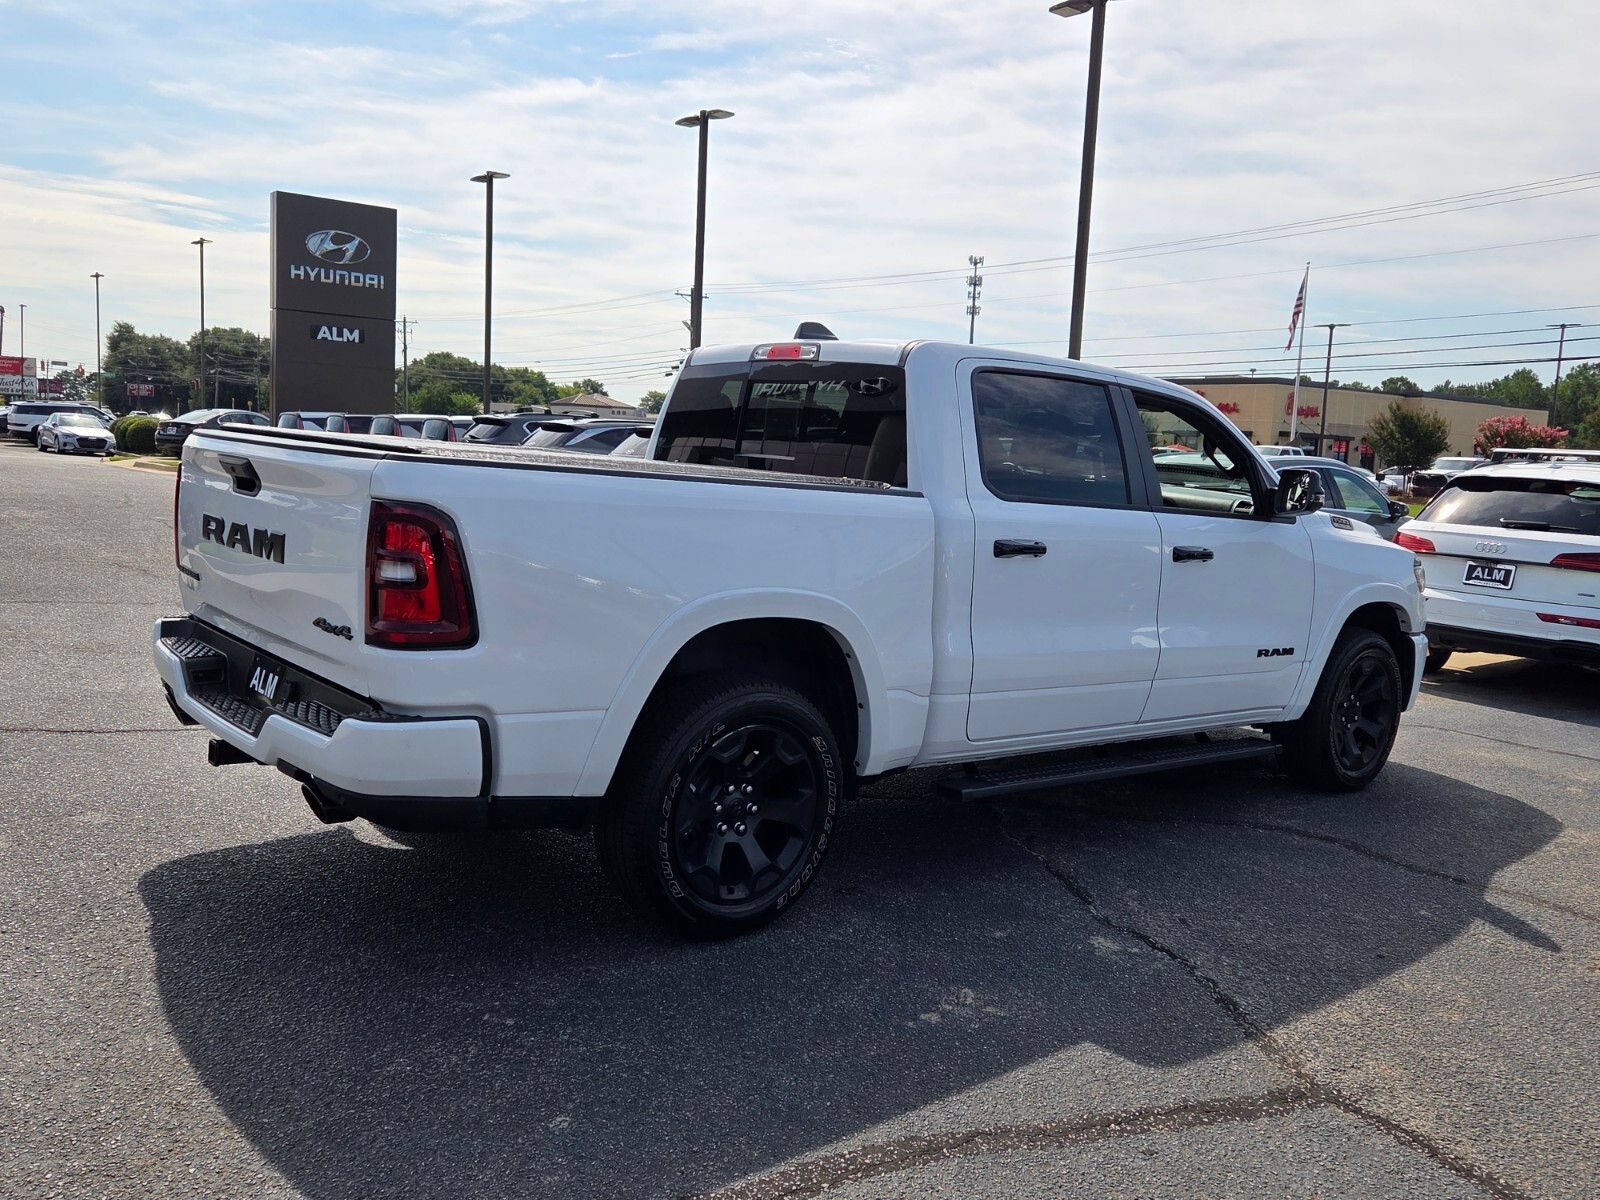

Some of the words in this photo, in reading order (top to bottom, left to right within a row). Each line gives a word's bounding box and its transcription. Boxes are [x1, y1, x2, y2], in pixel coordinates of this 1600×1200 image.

[290, 264, 385, 290] HYUNDAI
[316, 325, 360, 343] ALM
[202, 513, 285, 564] RAM
[1471, 567, 1506, 581] ALM
[1256, 647, 1294, 657] RAM
[249, 666, 279, 700] ALM
[658, 772, 685, 898] DUELER
[775, 735, 837, 910] BRIDGESTONE
